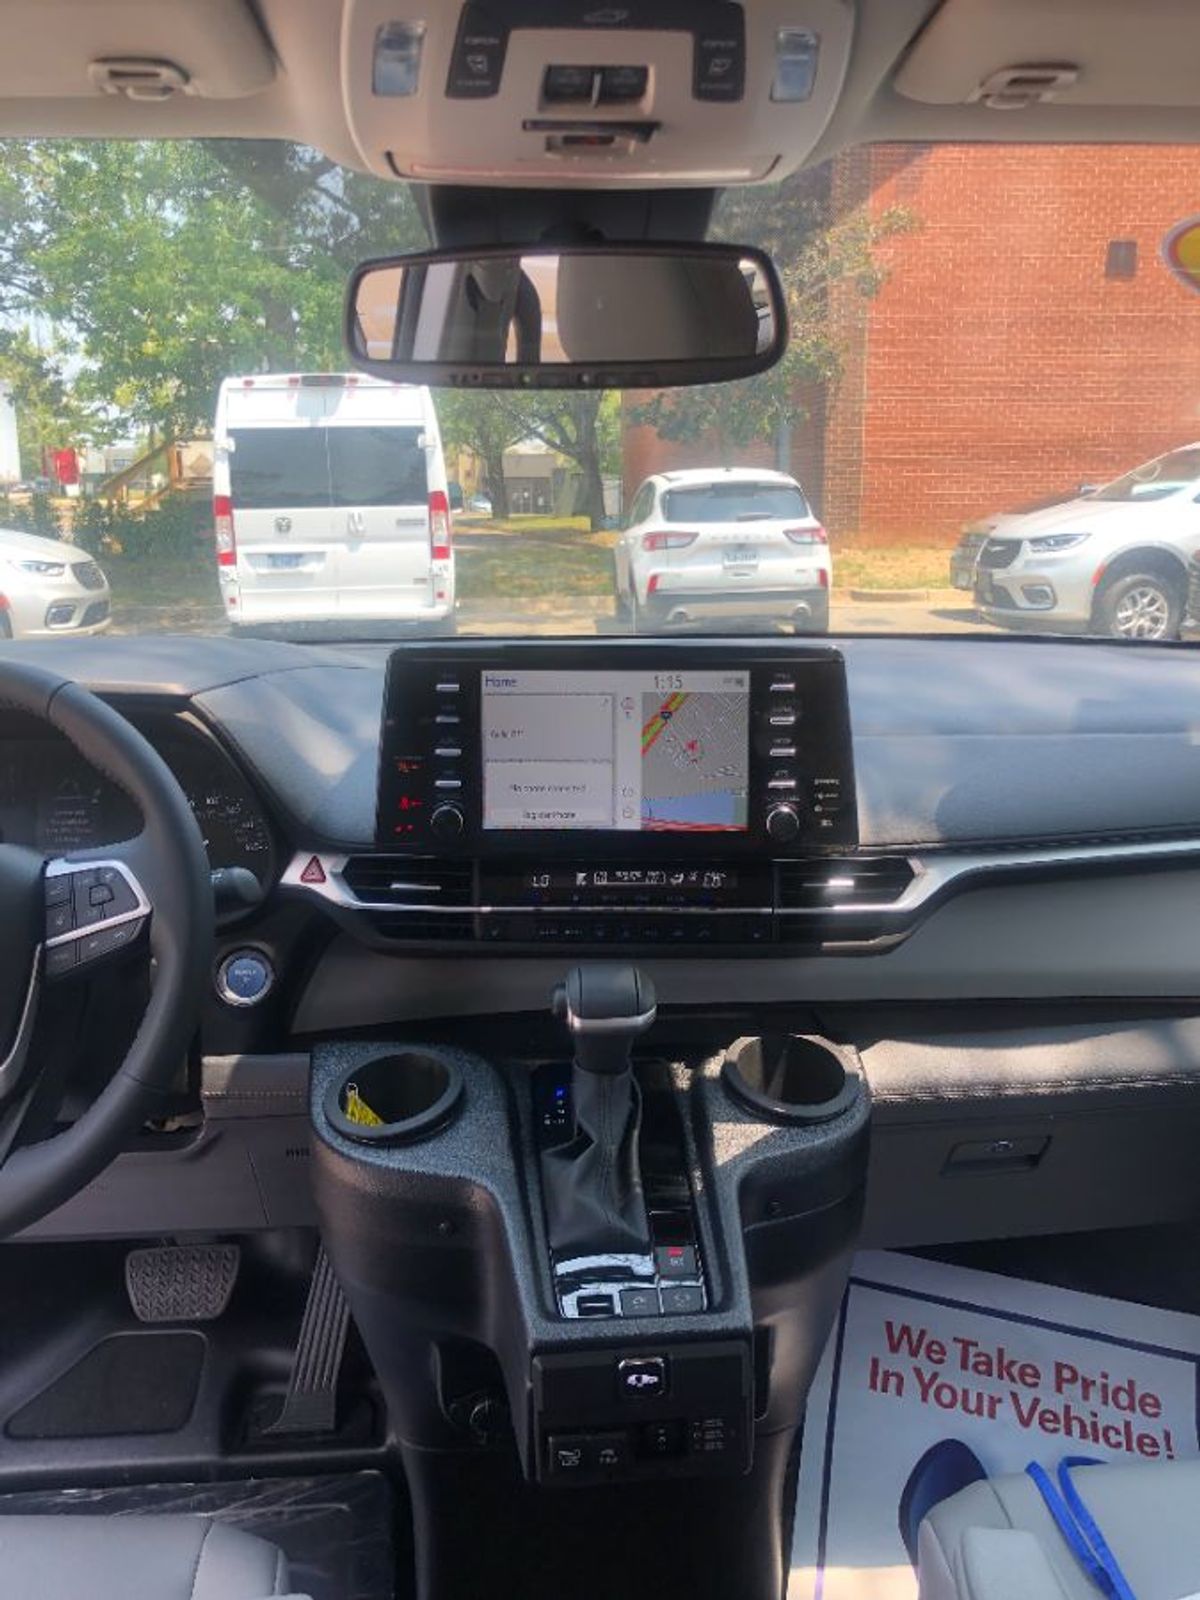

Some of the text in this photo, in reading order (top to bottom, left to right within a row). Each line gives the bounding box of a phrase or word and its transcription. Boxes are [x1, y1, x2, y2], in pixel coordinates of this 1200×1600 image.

[485, 675, 518, 688] Home
[654, 674, 683, 689] 1:15
[884, 1320, 1163, 1419] We Take Pride
[868, 1356, 1175, 1460] In Your Vehicle!
